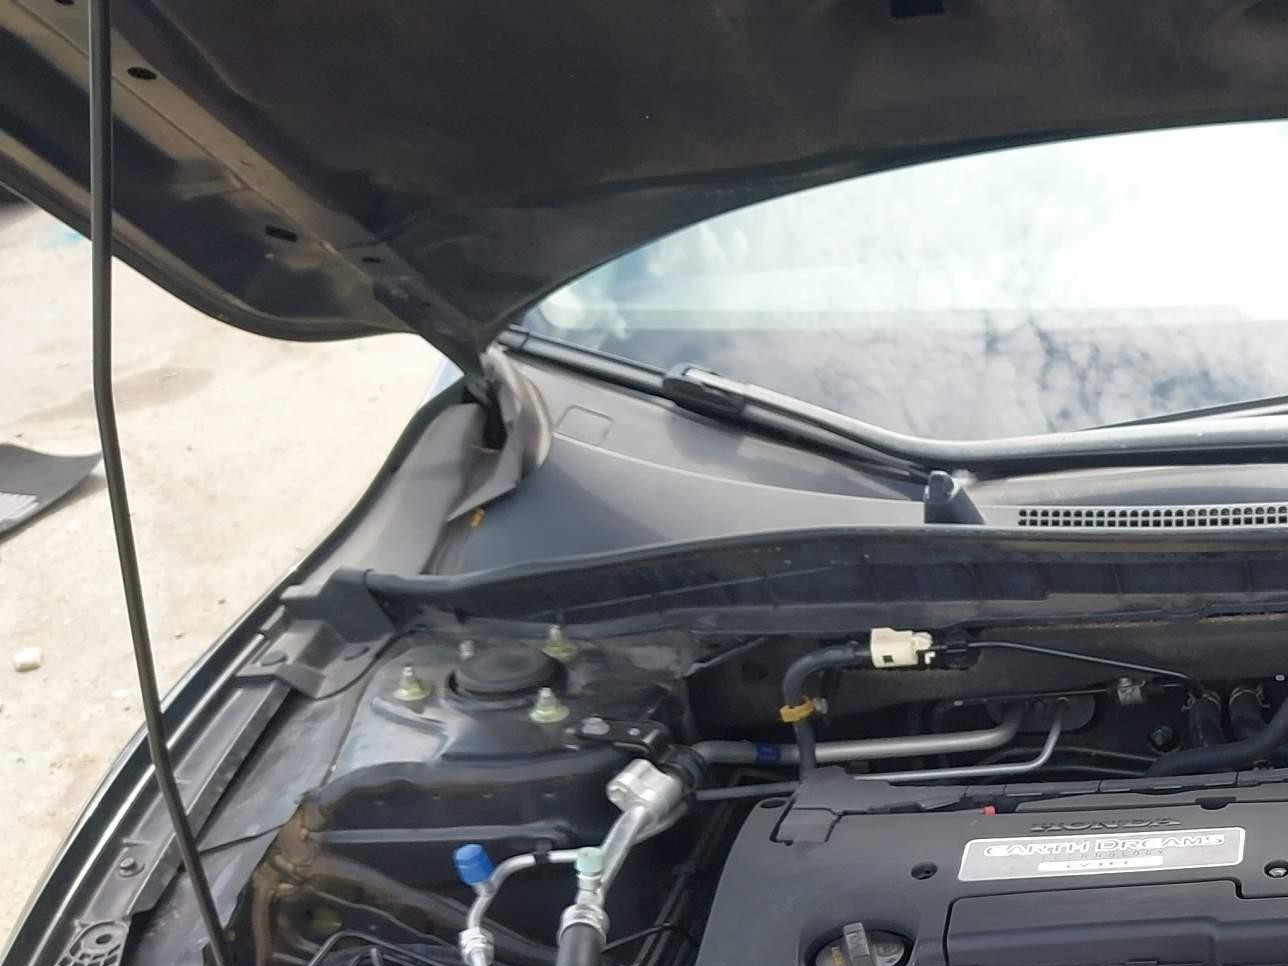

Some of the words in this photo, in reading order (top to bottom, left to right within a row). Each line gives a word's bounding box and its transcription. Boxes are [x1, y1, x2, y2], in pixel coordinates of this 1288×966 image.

[1030, 818, 1181, 833] HONDA
[983, 840, 1090, 857] EARTH
[1096, 834, 1224, 852] DREAMS
